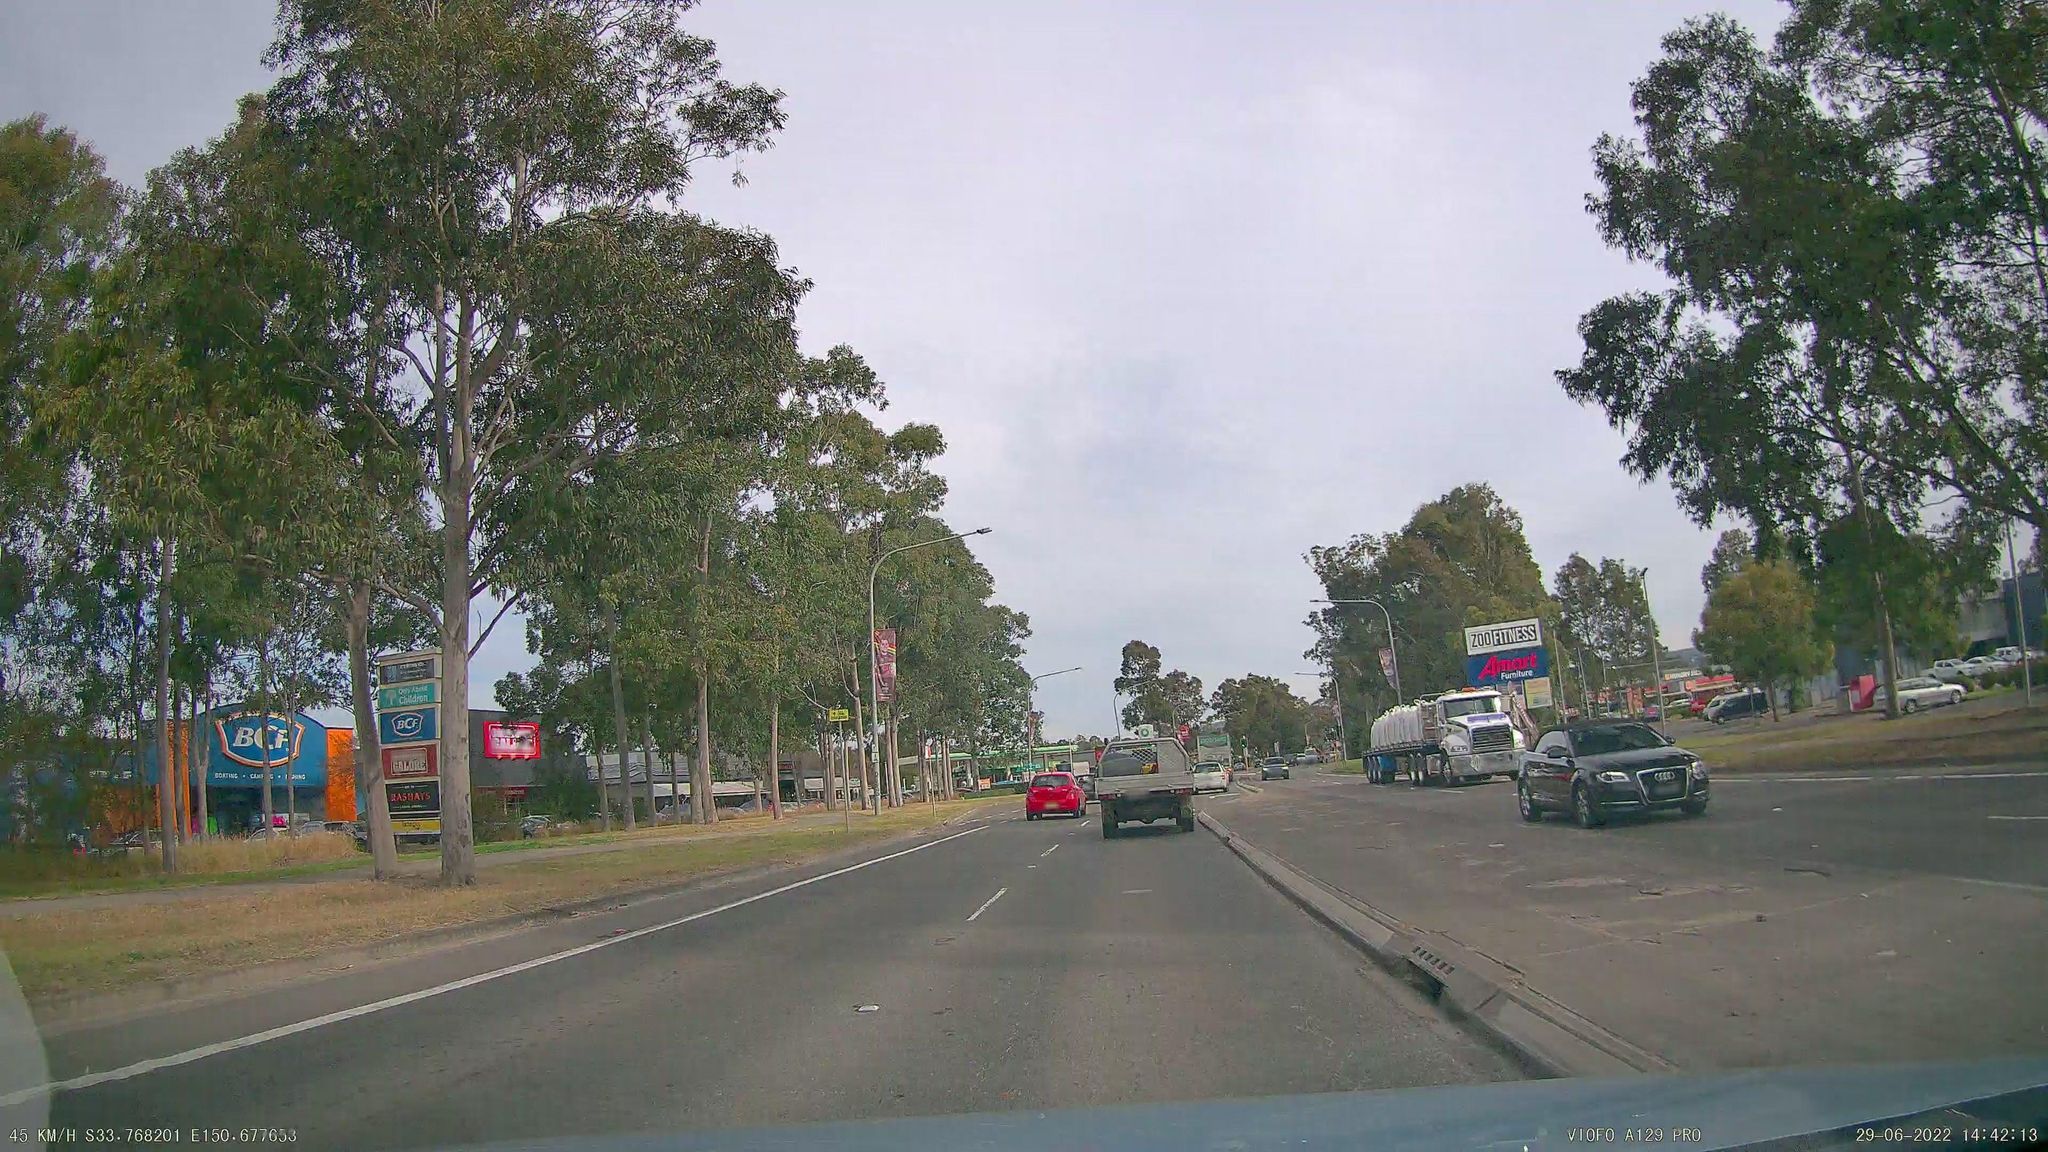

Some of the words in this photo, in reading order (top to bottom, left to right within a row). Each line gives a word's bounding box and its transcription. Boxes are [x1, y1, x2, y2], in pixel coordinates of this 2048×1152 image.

[1471, 632, 1491, 647] ZOO
[1492, 625, 1537, 646] FITNESS
[1478, 652, 1537, 680] Amart
[1501, 669, 1534, 680] Furniture
[397, 717, 418, 730] BCF
